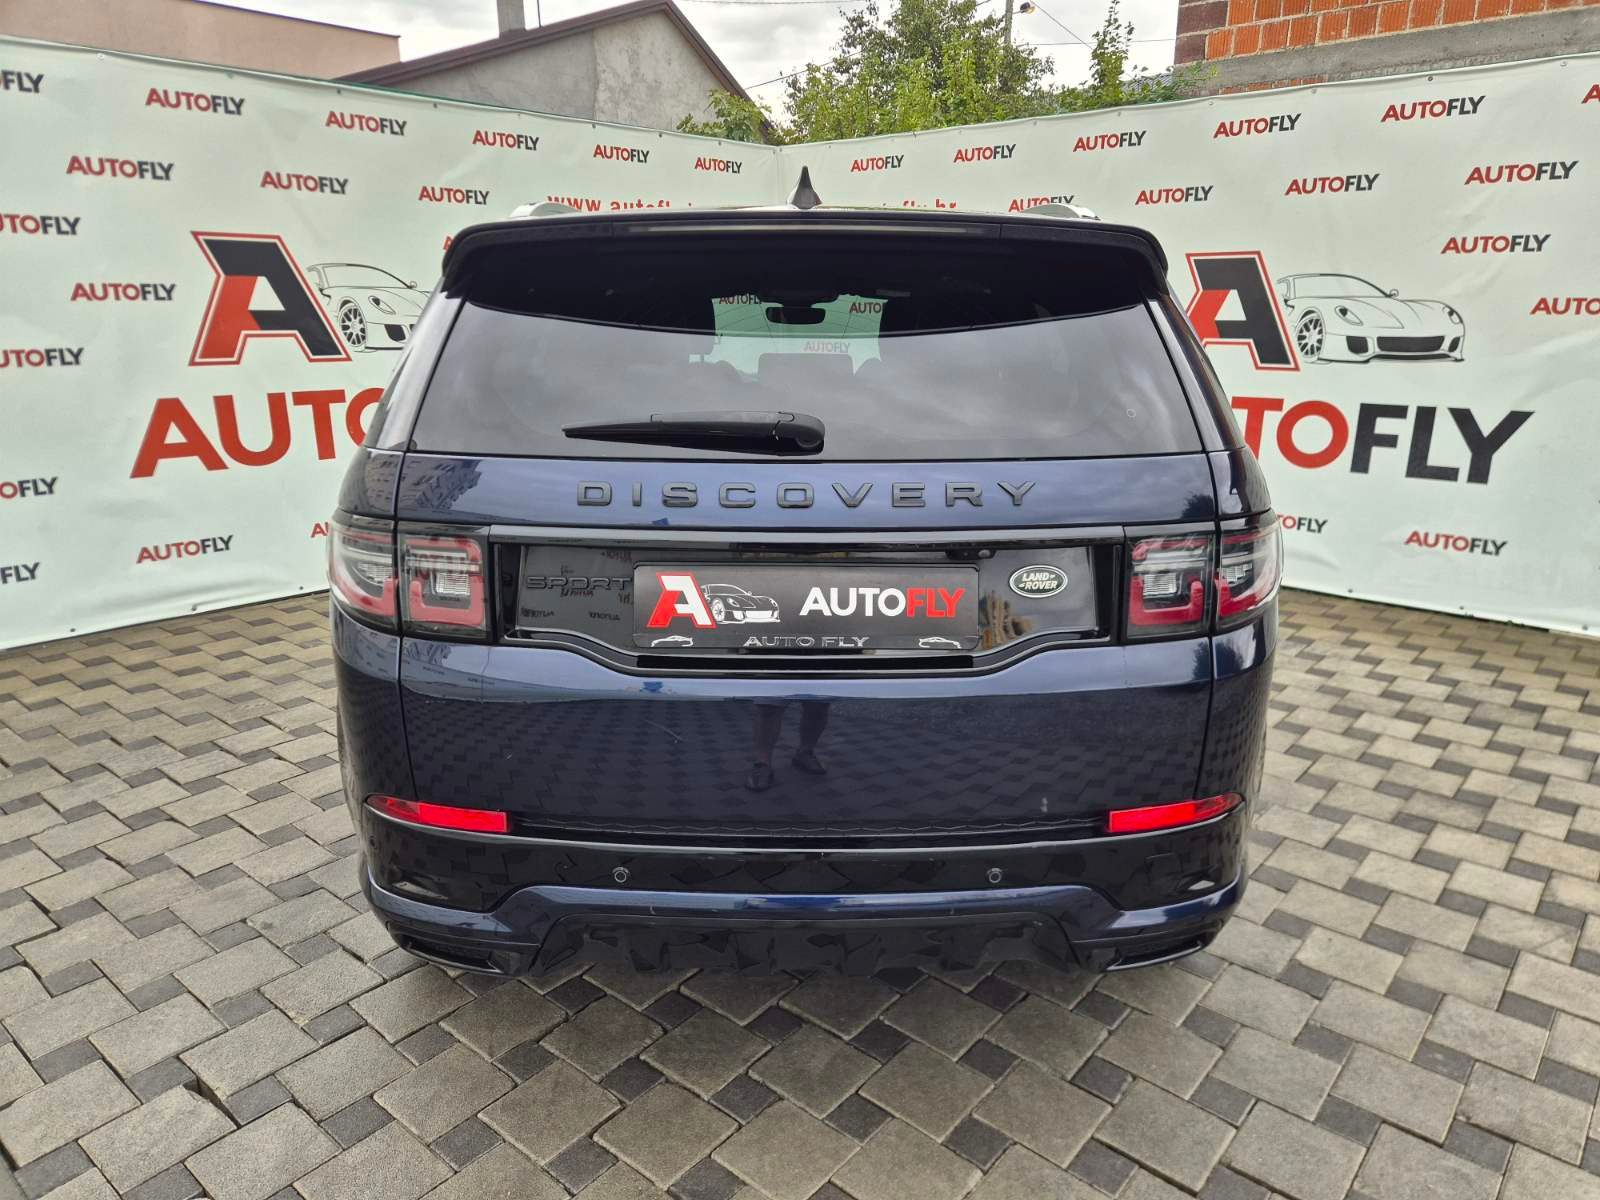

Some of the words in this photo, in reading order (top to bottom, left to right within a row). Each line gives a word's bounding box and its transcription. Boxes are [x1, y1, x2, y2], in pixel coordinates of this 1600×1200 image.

[145, 87, 246, 116] AUTOFLY
[1380, 95, 1487, 123] AUTOFLY
[325, 110, 408, 137] AUTOFLY
[1212, 112, 1302, 139] AUTOFLY
[471, 129, 540, 152] AUTOFLY
[1072, 130, 1147, 153] AUTOFLY
[592, 143, 650, 164] AUTOFLY
[850, 154, 905, 173] AUTOFLY
[953, 143, 1017, 164] AUTOFLY
[65, 155, 174, 181] AUTOFLY
[694, 156, 743, 175] AUTOFLY
[1463, 160, 1579, 186] AUTOFLY
[260, 170, 349, 195] AUTOFLY
[1284, 173, 1381, 196] AUTOFLY
[418, 185, 490, 206] AUTOFLY
[1134, 184, 1214, 206] AUTOFLY
[0, 212, 81, 236] TOFLY
[1440, 233, 1552, 255] AUTOFLY
[70, 282, 177, 302] AUTOFLY
[803, 341, 849, 354] AUTOFLY
[575, 480, 1038, 508] DISCOVERY
[135, 534, 234, 564] AUTOFLY
[1404, 530, 1508, 557] AUTOFLY
[526, 576, 633, 591] SPORT
[1022, 572, 1050, 582] LAND
[1023, 580, 1058, 590] ROVER
[799, 586, 967, 618] AUTOFLY
[743, 636, 816, 648] AUTO
[821, 636, 872, 648] FLY
